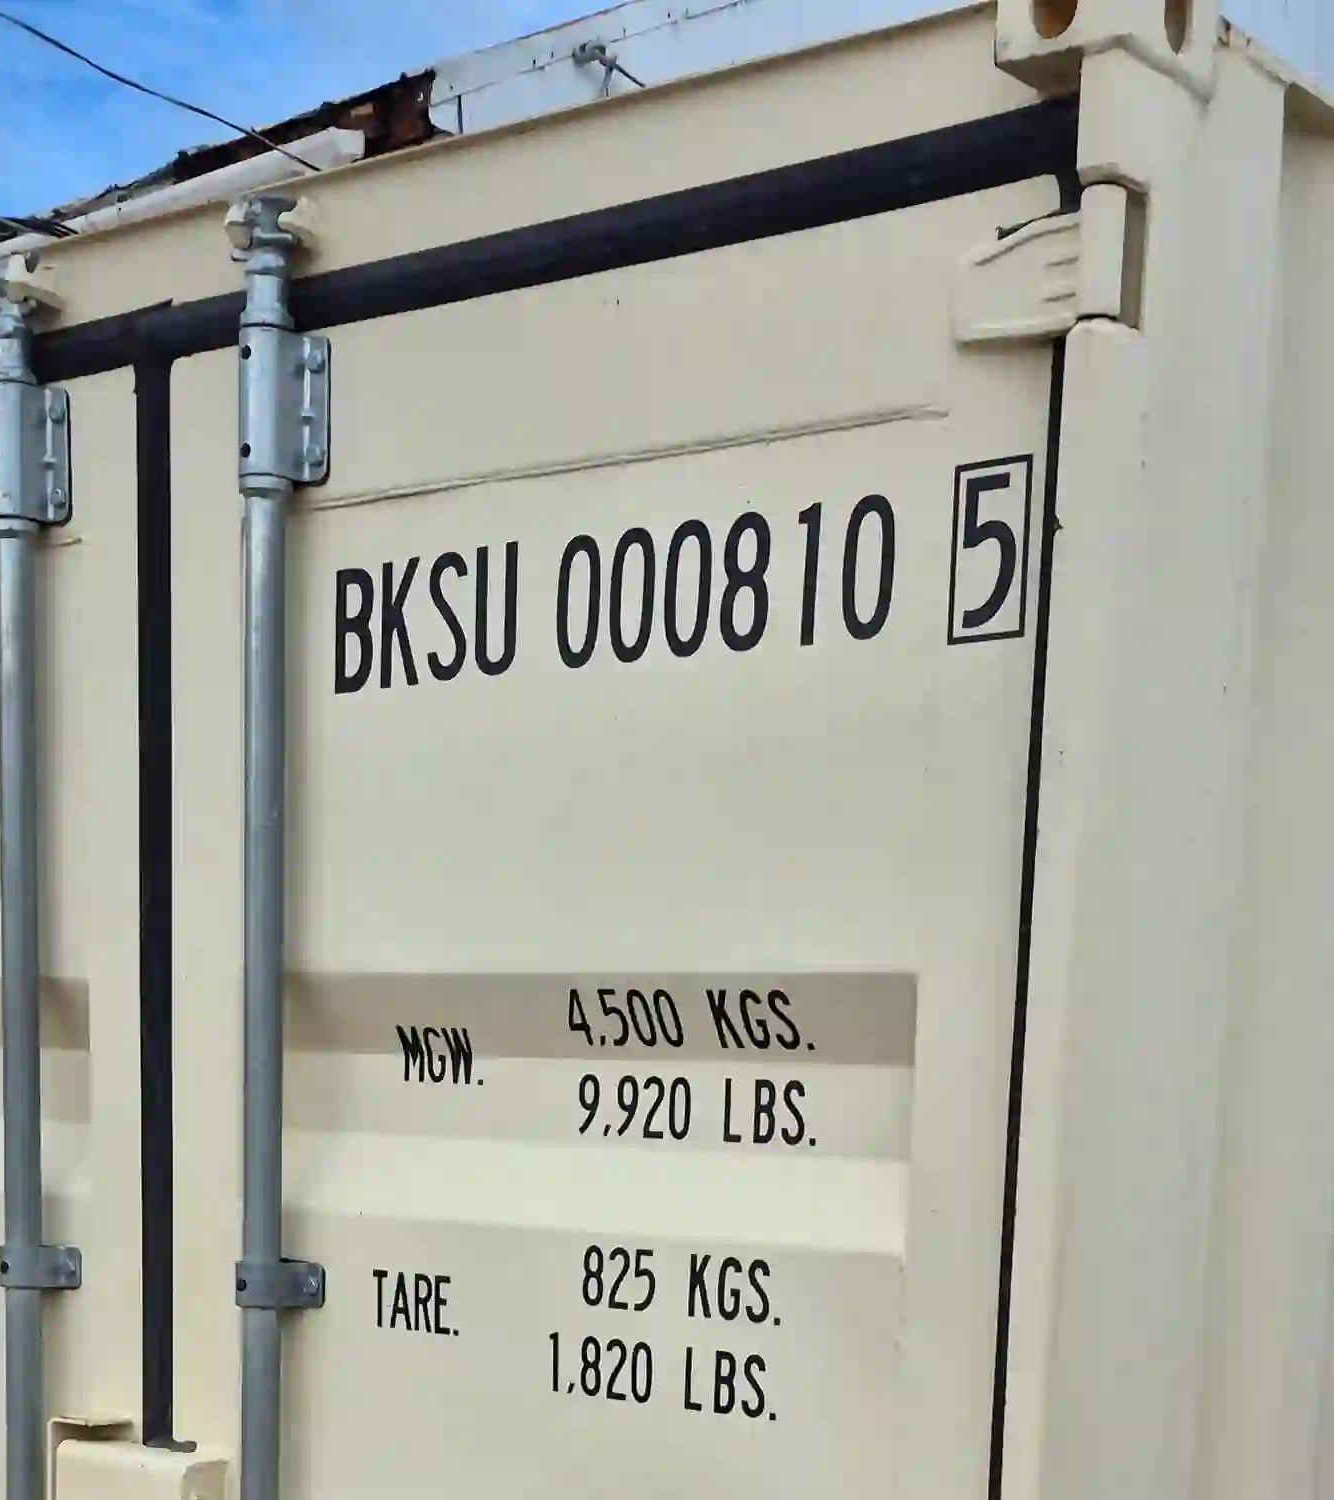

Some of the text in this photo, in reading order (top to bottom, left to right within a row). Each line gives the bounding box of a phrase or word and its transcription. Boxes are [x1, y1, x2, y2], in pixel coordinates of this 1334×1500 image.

[334, 471, 1018, 695] BKSU 000810 5
[395, 1024, 484, 1086] MGW.
[705, 988, 816, 1051] KGS.
[578, 1074, 817, 1147] 9,920 LBS.
[372, 1244, 781, 1337] TARE. 825 KGS.
[549, 1331, 777, 1421] 1,820 LBS.
